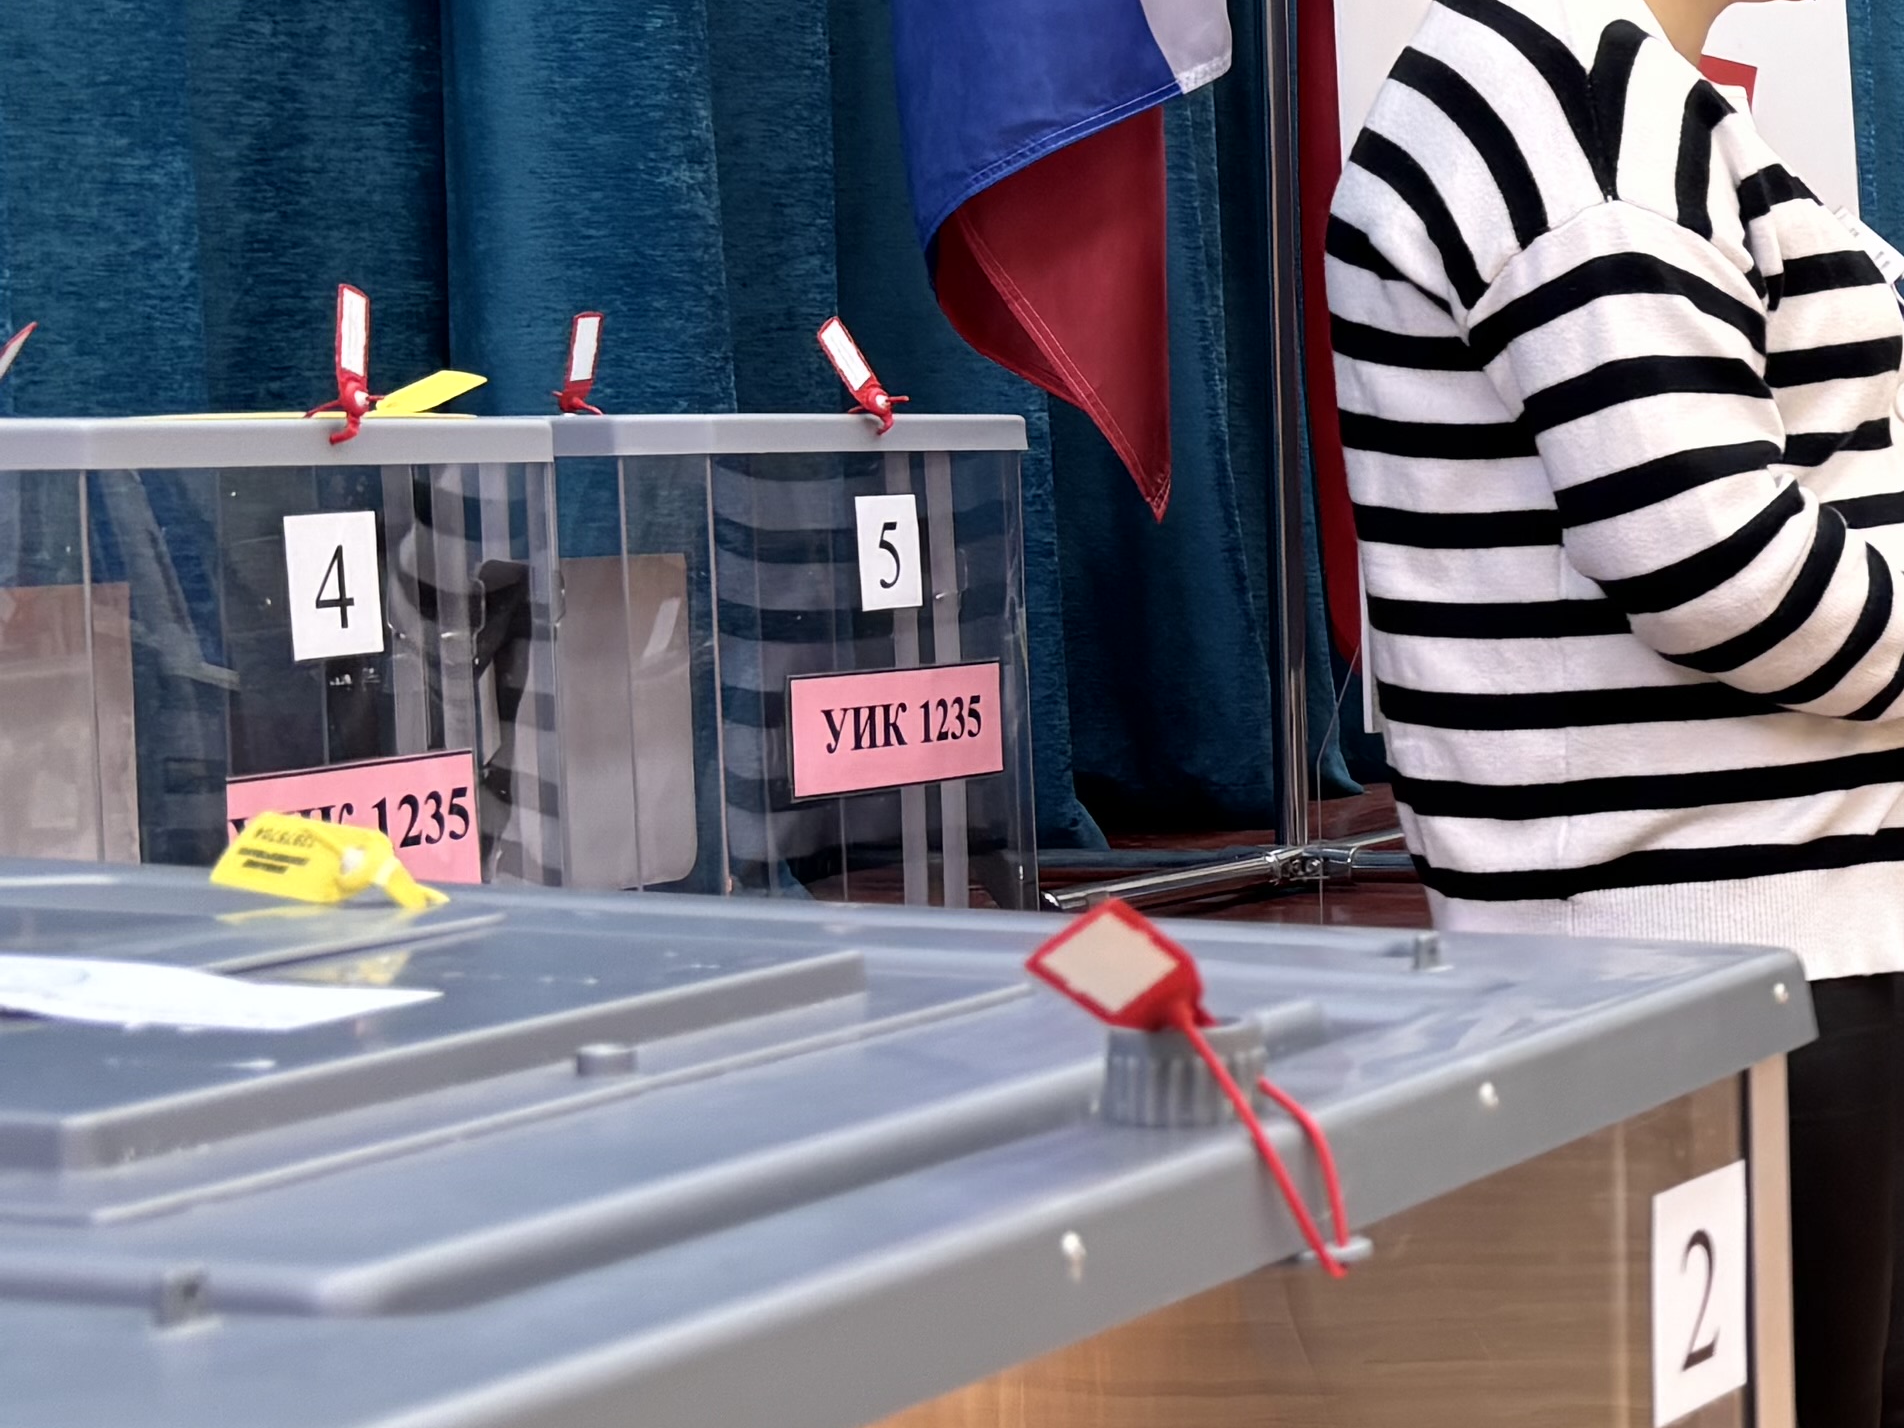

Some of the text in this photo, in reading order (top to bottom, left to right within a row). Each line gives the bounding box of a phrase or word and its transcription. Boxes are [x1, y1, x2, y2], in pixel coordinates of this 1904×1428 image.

[314, 544, 354, 629] 4
[878, 521, 901, 590] 5
[821, 695, 983, 754] УИК 1235
[372, 786, 470, 849] 1235
[1681, 1228, 1720, 1374] 2
